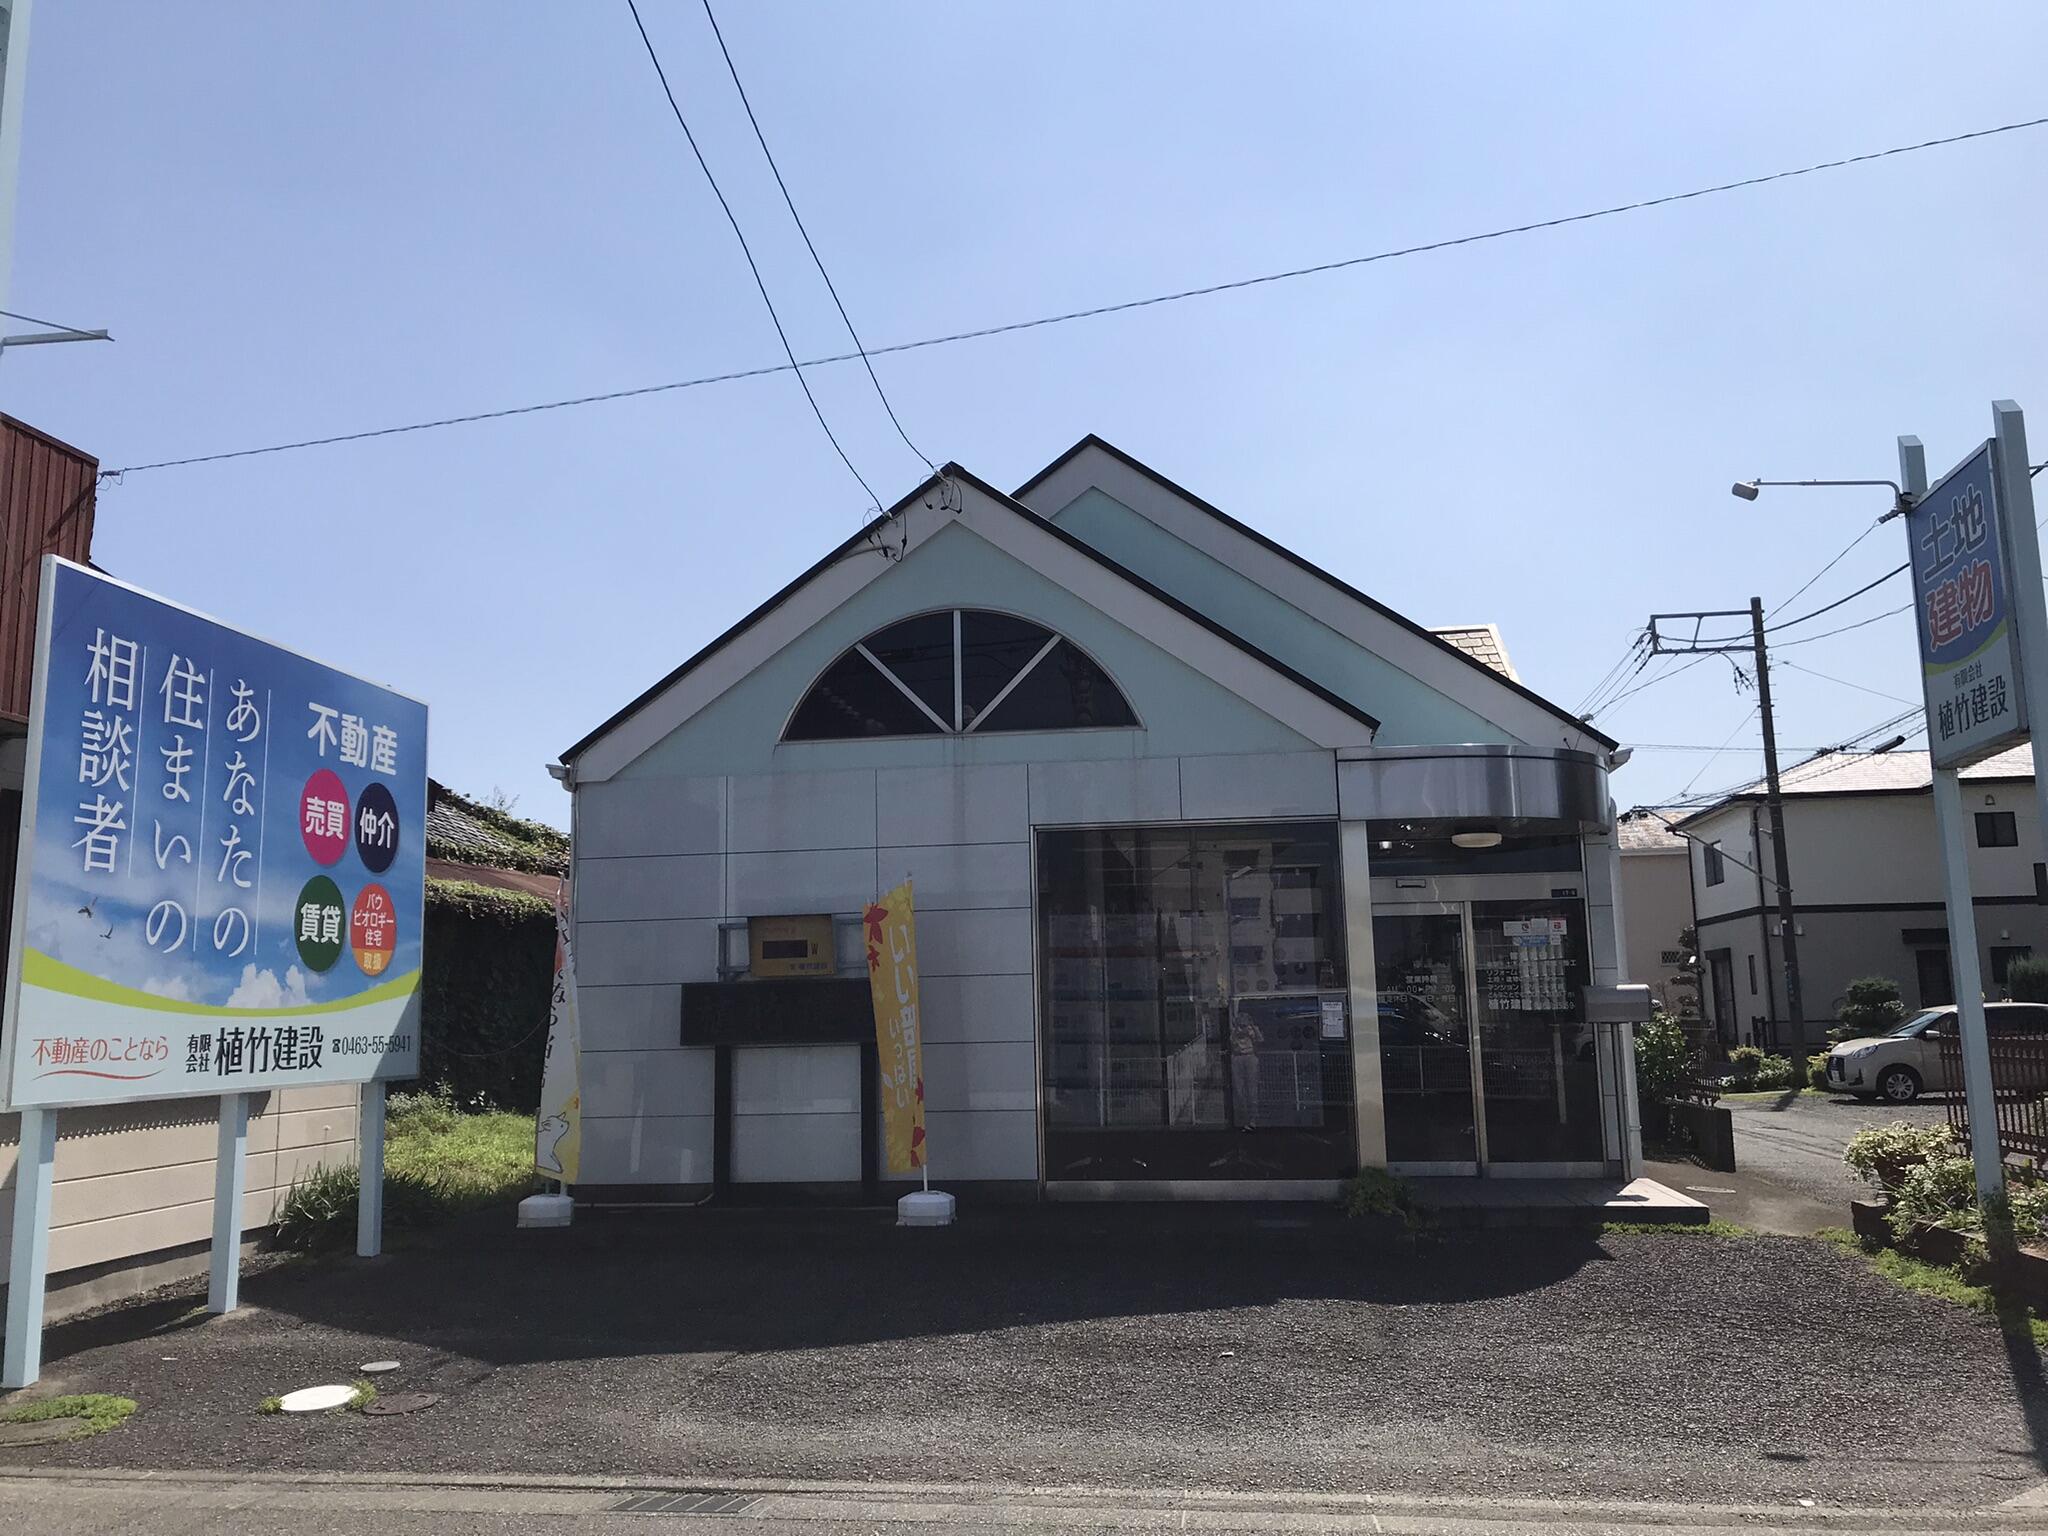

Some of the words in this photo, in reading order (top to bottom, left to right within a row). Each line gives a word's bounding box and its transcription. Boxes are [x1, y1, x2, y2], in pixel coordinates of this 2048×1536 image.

[1921, 482, 1987, 583] 土地
[1925, 558, 1994, 652] 建物
[1938, 674, 2008, 741] 植竹建設
[71, 627, 138, 873] 相談者
[307, 701, 398, 776] 不動産
[145, 654, 206, 954] 住まいの
[214, 678, 261, 958] あなたの
[305, 796, 345, 840] 売買
[359, 806, 395, 849] 仲介
[300, 902, 341, 944] 賃貸
[364, 928, 382, 947] 住宅
[31, 1036, 169, 1066] 不動産のことなら
[185, 1053, 210, 1073] 会社
[187, 1034, 212, 1053] 有限
[214, 1026, 324, 1076] 植竹建設
[342, 1036, 411, 1054] 0463-55-5941
